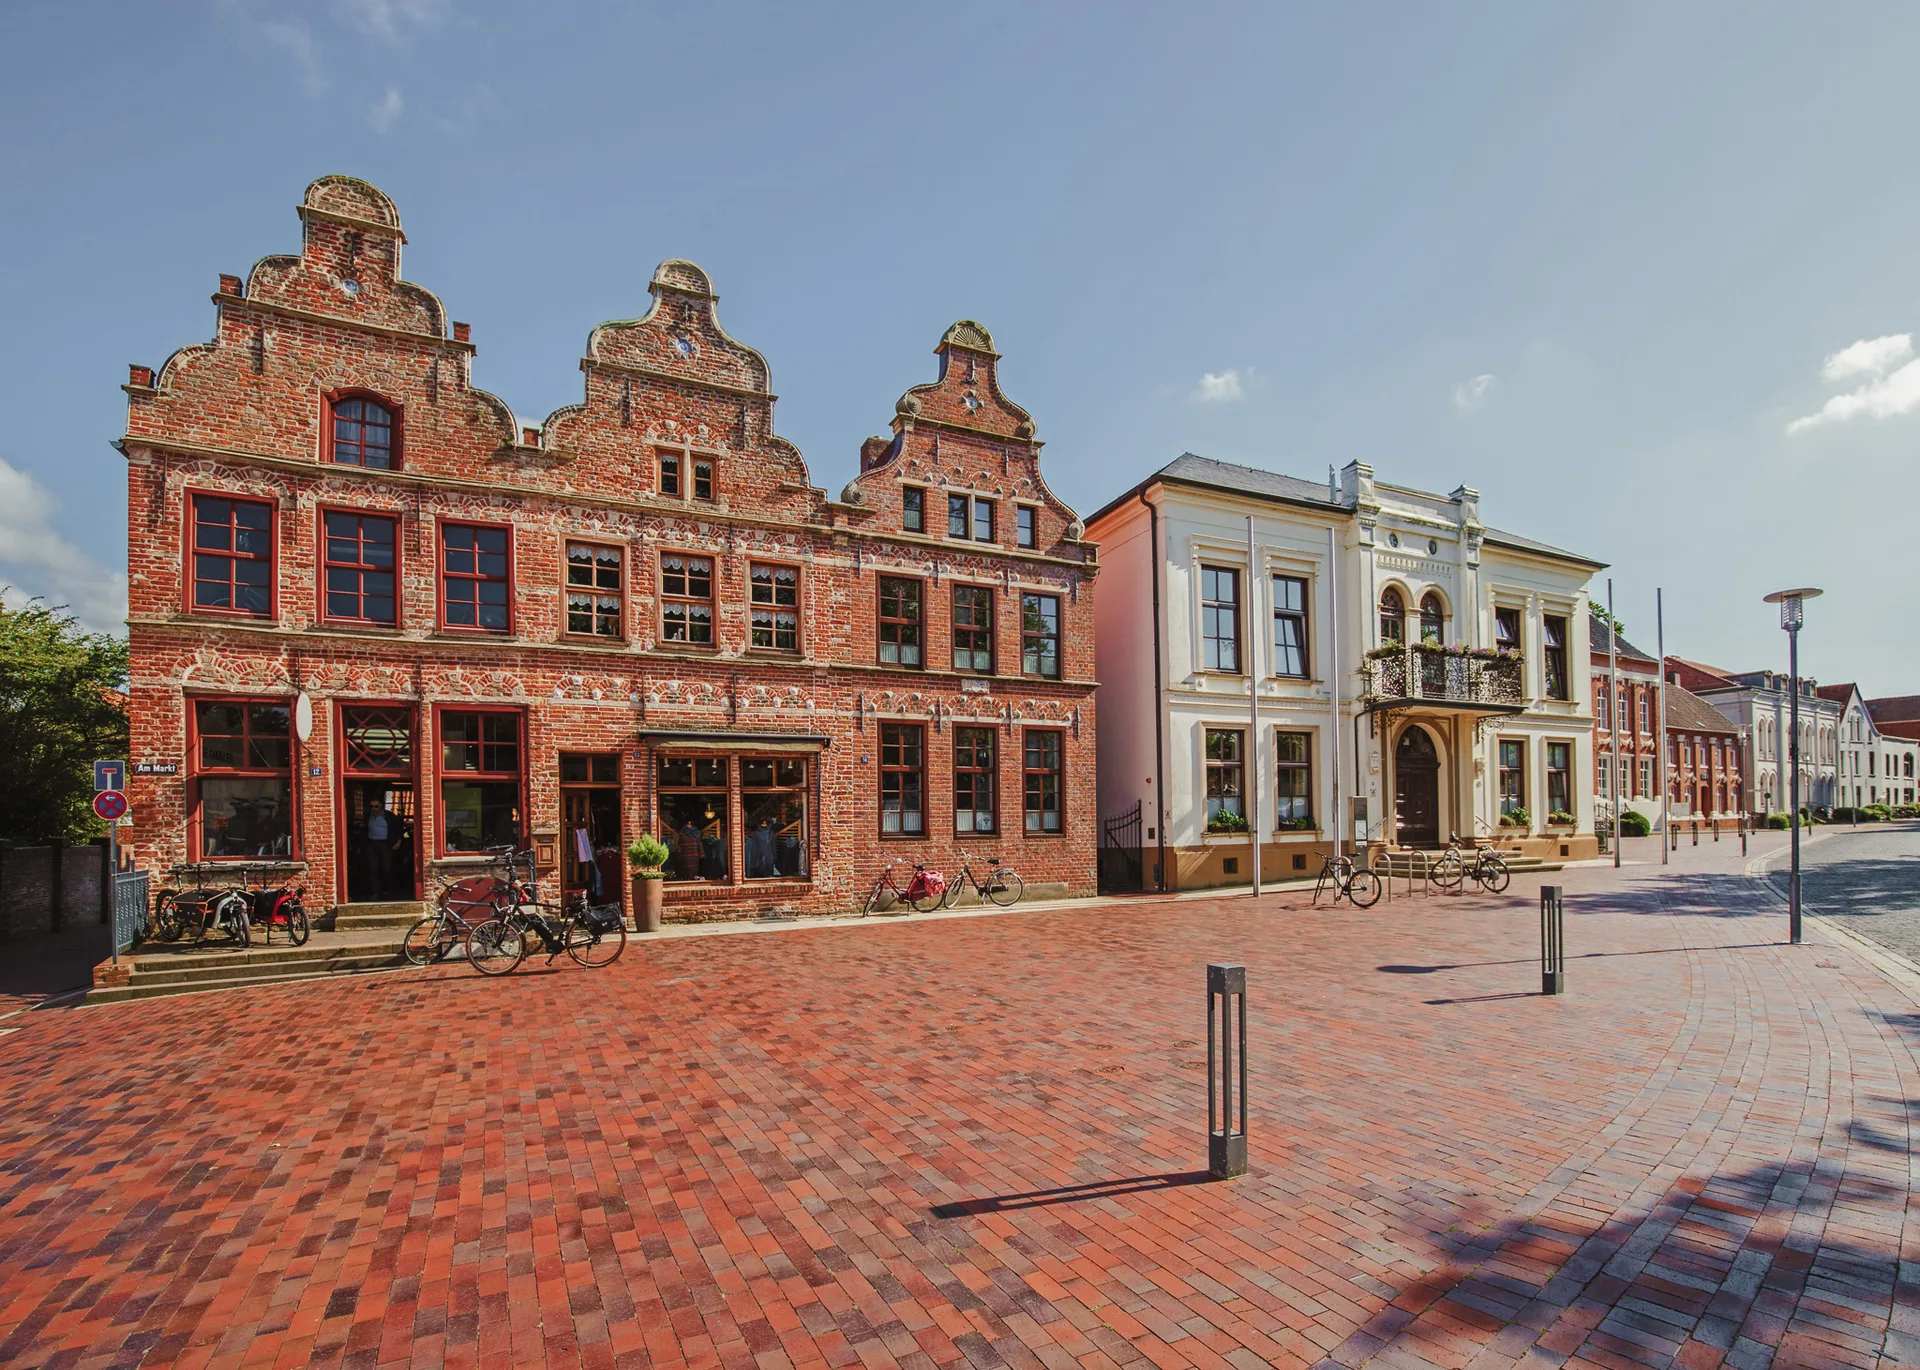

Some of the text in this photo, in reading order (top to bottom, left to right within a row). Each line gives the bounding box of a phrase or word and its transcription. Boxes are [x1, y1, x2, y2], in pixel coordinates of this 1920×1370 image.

[138, 764, 176, 772] Am Markt
[313, 768, 320, 776] 12
